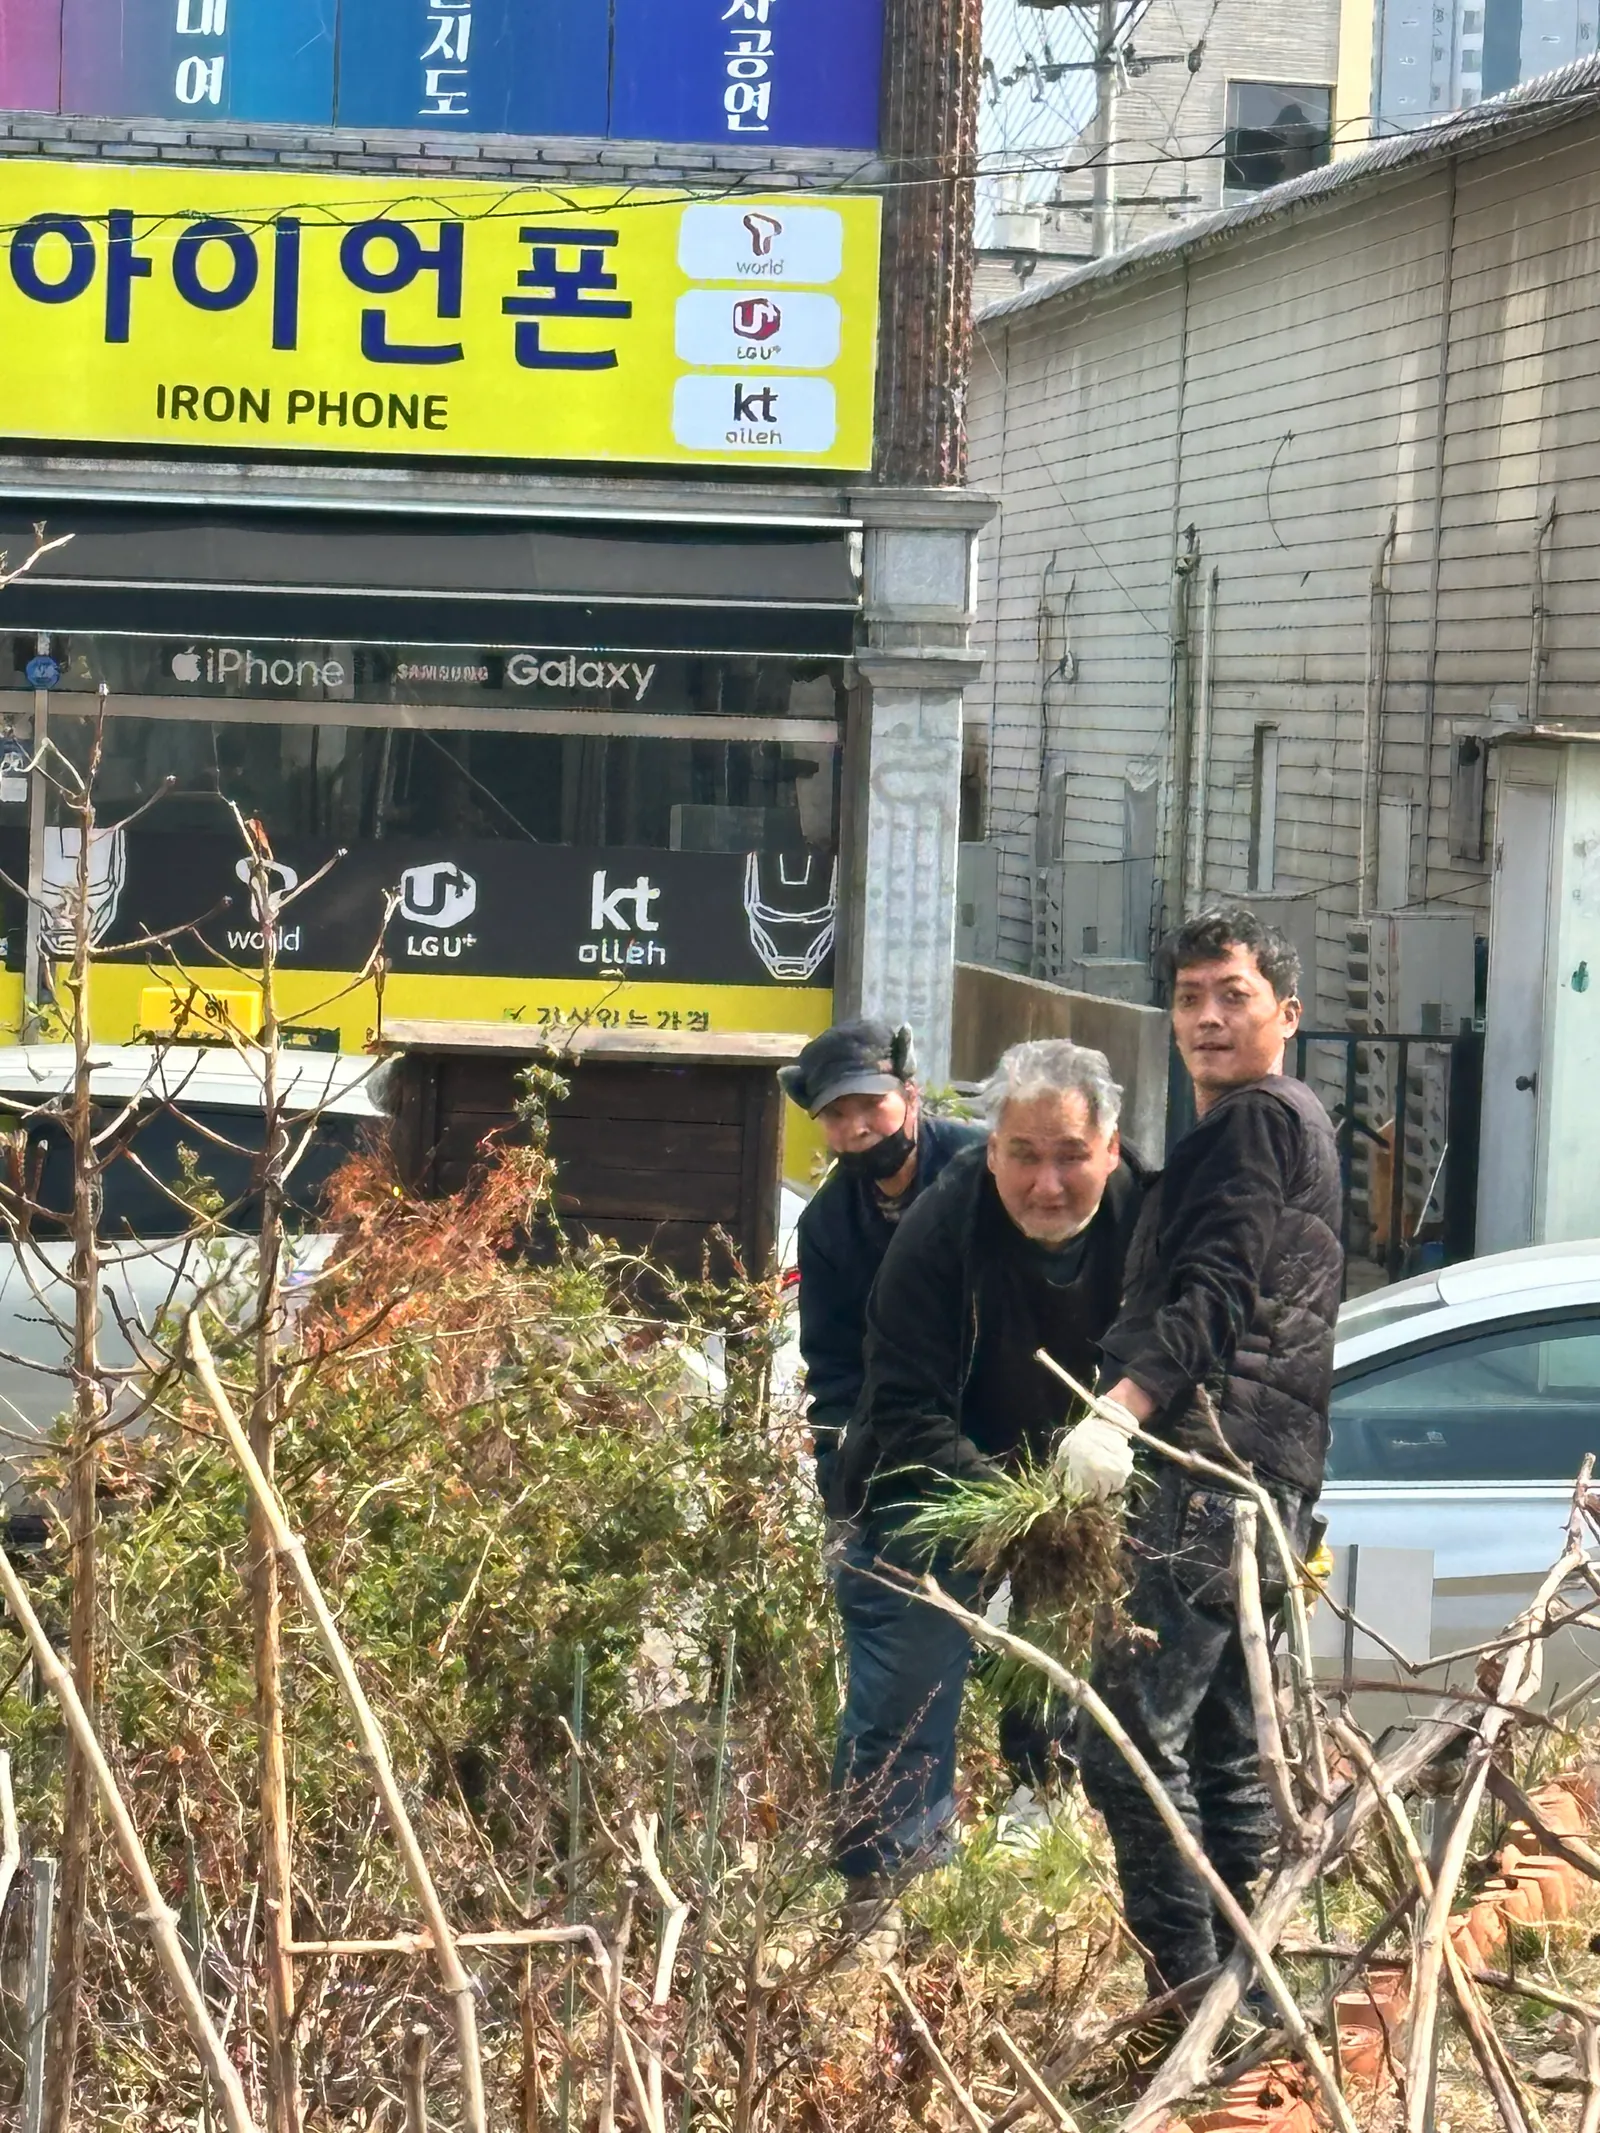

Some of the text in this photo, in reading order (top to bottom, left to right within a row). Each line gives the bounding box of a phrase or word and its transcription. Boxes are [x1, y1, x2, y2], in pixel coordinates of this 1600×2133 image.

[418, 0, 472, 115] 지도
[736, 259, 784, 276] world
[9, 209, 633, 371] 아이언폰
[156, 384, 449, 431] IRON PHONE
[733, 383, 778, 423] kt
[206, 648, 345, 688] iPhone
[507, 653, 656, 701] Galaxy
[591, 870, 661, 931] kt
[227, 925, 300, 951] wold
[579, 938, 666, 965] olleh
